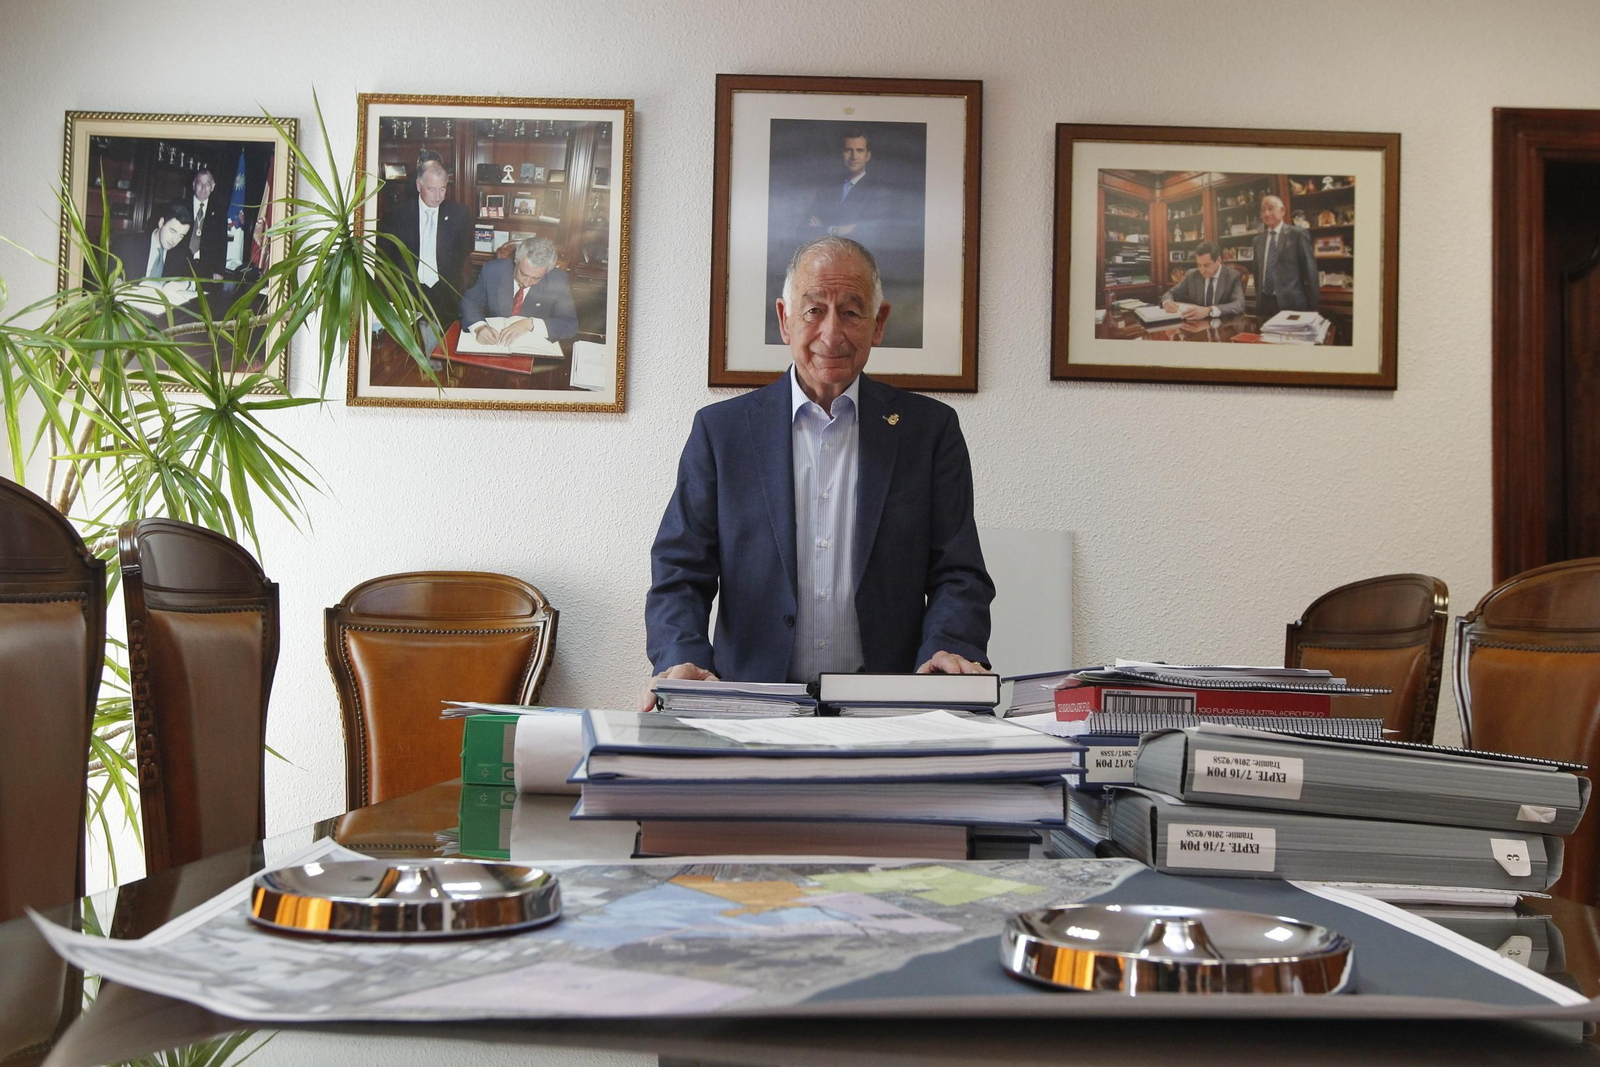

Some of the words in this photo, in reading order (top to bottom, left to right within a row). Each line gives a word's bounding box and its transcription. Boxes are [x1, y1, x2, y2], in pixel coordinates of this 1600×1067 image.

[1212, 707, 1245, 715] FUNDAS
[1095, 758, 1112, 768] POM
[1252, 760, 1281, 769] Trámite:
[1207, 766, 1227, 778] POM
[1230, 768, 1252, 780] 7/16
[1256, 770, 1286, 783] EXPTE.
[1225, 831, 1254, 840] Trámite:
[1180, 839, 1200, 851] POM
[1203, 840, 1225, 853] 7/16
[1228, 842, 1260, 854] EXPTE.
[1506, 853, 1520, 861] 3
